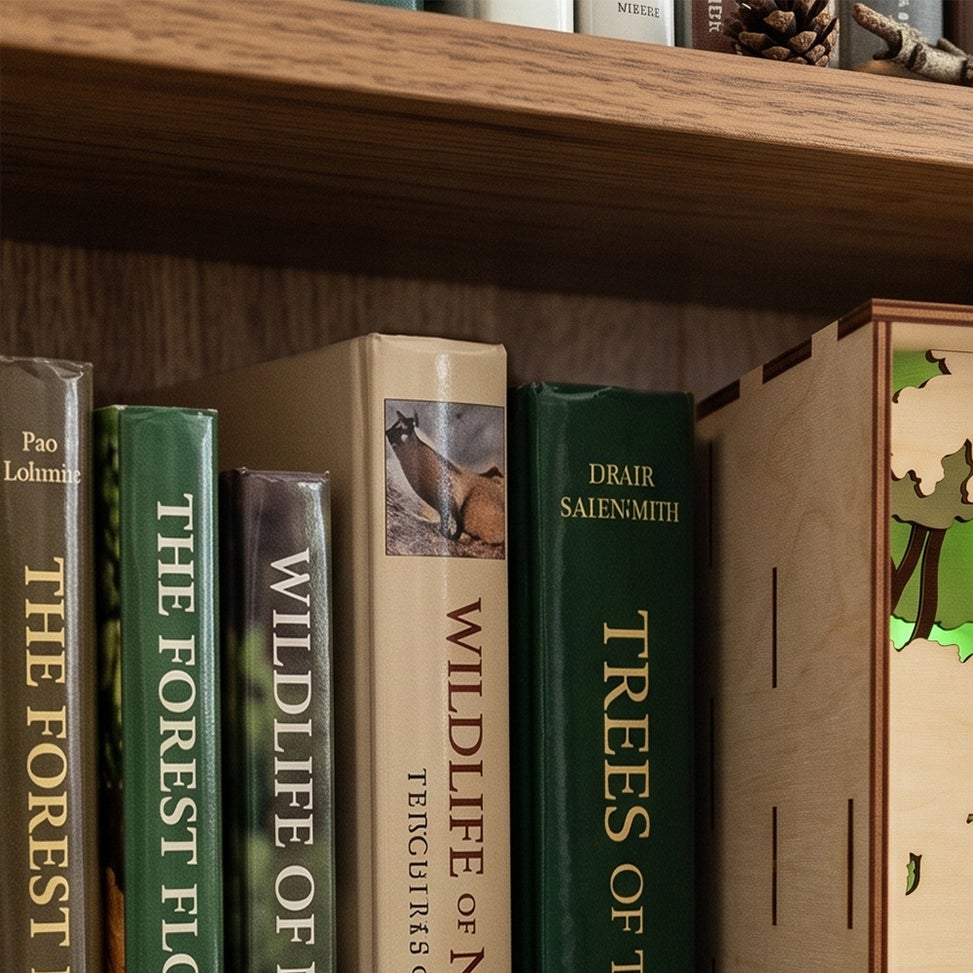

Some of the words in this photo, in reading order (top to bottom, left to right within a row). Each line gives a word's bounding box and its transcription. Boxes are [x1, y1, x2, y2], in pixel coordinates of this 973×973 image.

[22, 431, 58, 452] Pao
[589, 463, 655, 487] DRAIR
[155, 492, 196, 617] THE
[24, 557, 66, 688] THE
[156, 634, 199, 866] FOREST
[269, 547, 315, 849] WILDLIFE
[447, 597, 485, 879] WILDLIFE
[602, 608, 650, 844] TREES
[26, 705, 71, 947] FOREST
[275, 864, 316, 945] OF
[456, 893, 478, 937] OF
[610, 862, 645, 936] OF
